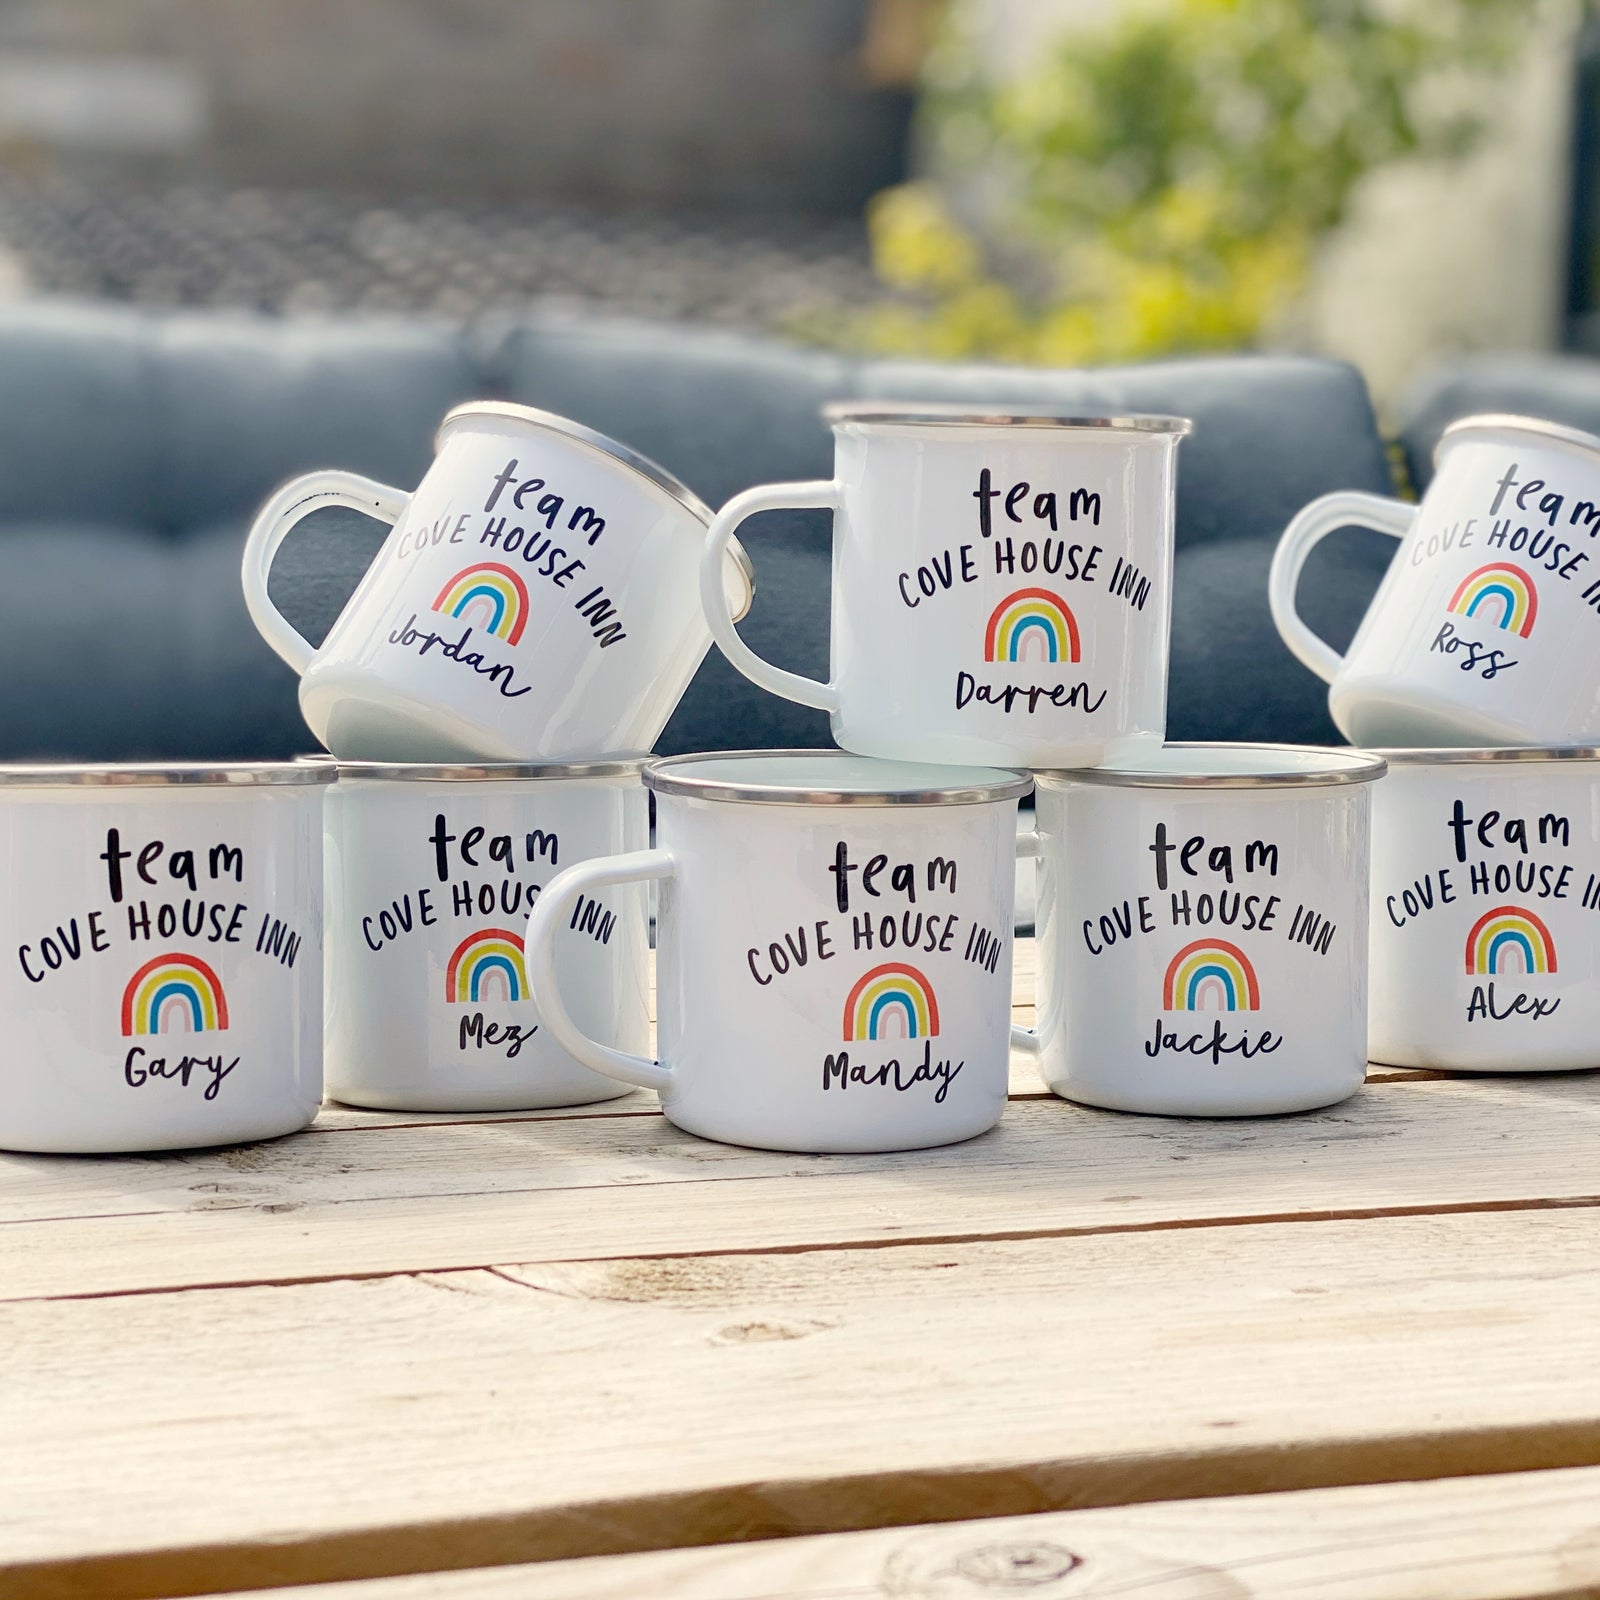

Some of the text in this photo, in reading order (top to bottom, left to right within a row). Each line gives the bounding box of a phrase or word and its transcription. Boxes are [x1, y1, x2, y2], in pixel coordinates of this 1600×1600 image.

[483, 459, 606, 546] team
[973, 468, 1101, 538] team
[1489, 463, 1600, 538] team
[397, 514, 627, 649] COVE HOUSE INN
[899, 537, 1151, 611] COVE HOUSE INN
[1411, 519, 1589, 580] COVE HOUSE
[388, 614, 532, 698] Jordan
[1430, 621, 1518, 680] Ross
[956, 671, 1107, 713] Darren
[429, 814, 558, 882] team
[1149, 822, 1278, 890] team
[1447, 799, 1570, 863] team
[100, 828, 243, 903] team
[828, 841, 957, 913] team
[1386, 869, 1457, 927] COVE
[1470, 860, 1574, 898] HOUSE
[18, 899, 301, 983] COVE HOUSE INN
[362, 879, 617, 951] COVE HOUS INN
[748, 910, 1001, 985] COVE HOUSE INN
[1083, 889, 1336, 955] COVE HOUSE INN
[459, 1012, 538, 1058] Mez
[1466, 982, 1561, 1023] Alex
[124, 1046, 240, 1100] Gary
[823, 1040, 964, 1103] Mandy
[1145, 1018, 1282, 1065] Jackie
